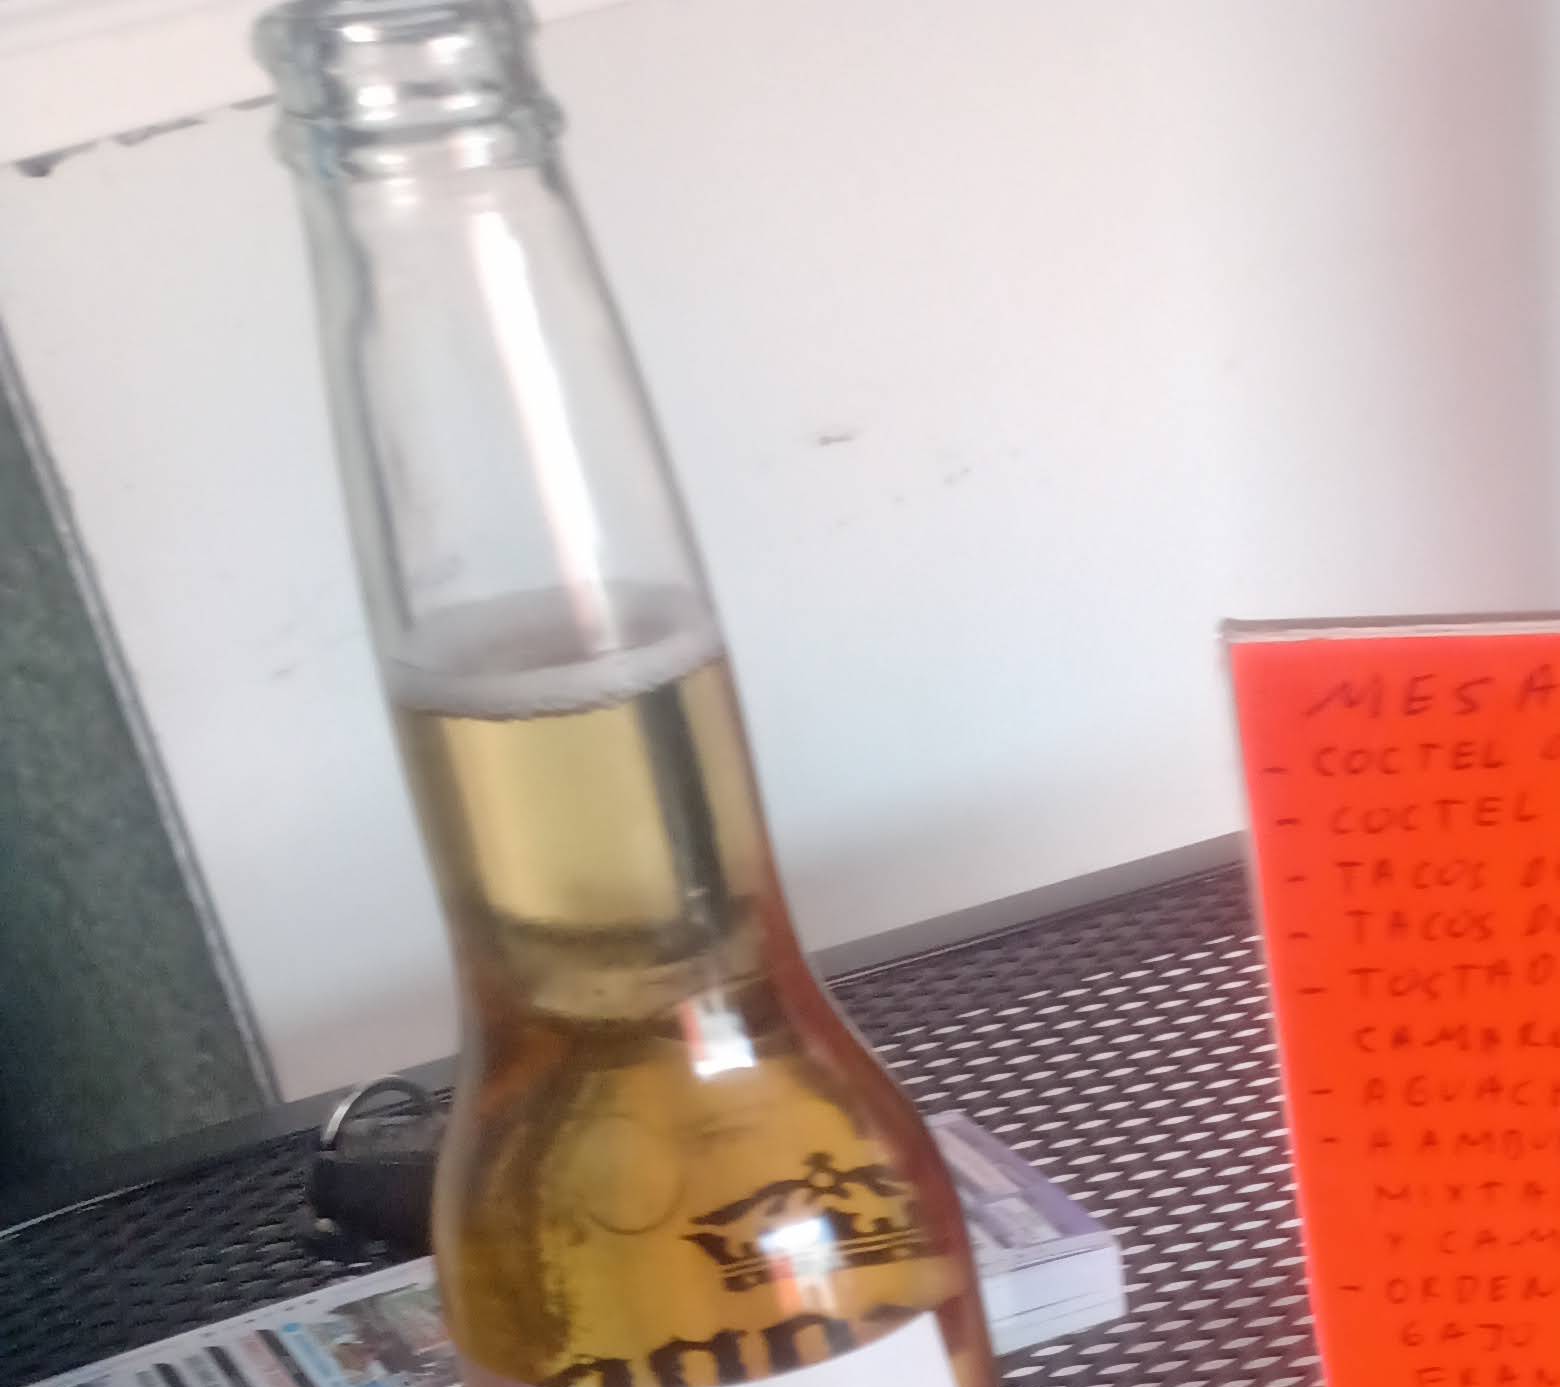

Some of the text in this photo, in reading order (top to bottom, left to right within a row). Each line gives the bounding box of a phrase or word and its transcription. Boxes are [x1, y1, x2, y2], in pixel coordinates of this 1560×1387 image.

[1301, 664, 1559, 718] MESA
[1311, 741, 1505, 777] COCTEL
[1328, 792, 1541, 835] COCTEL
[1335, 857, 1488, 890] TACOS
[1344, 906, 1496, 945] TACOS
[1384, 1274, 1560, 1305] ORDEN
